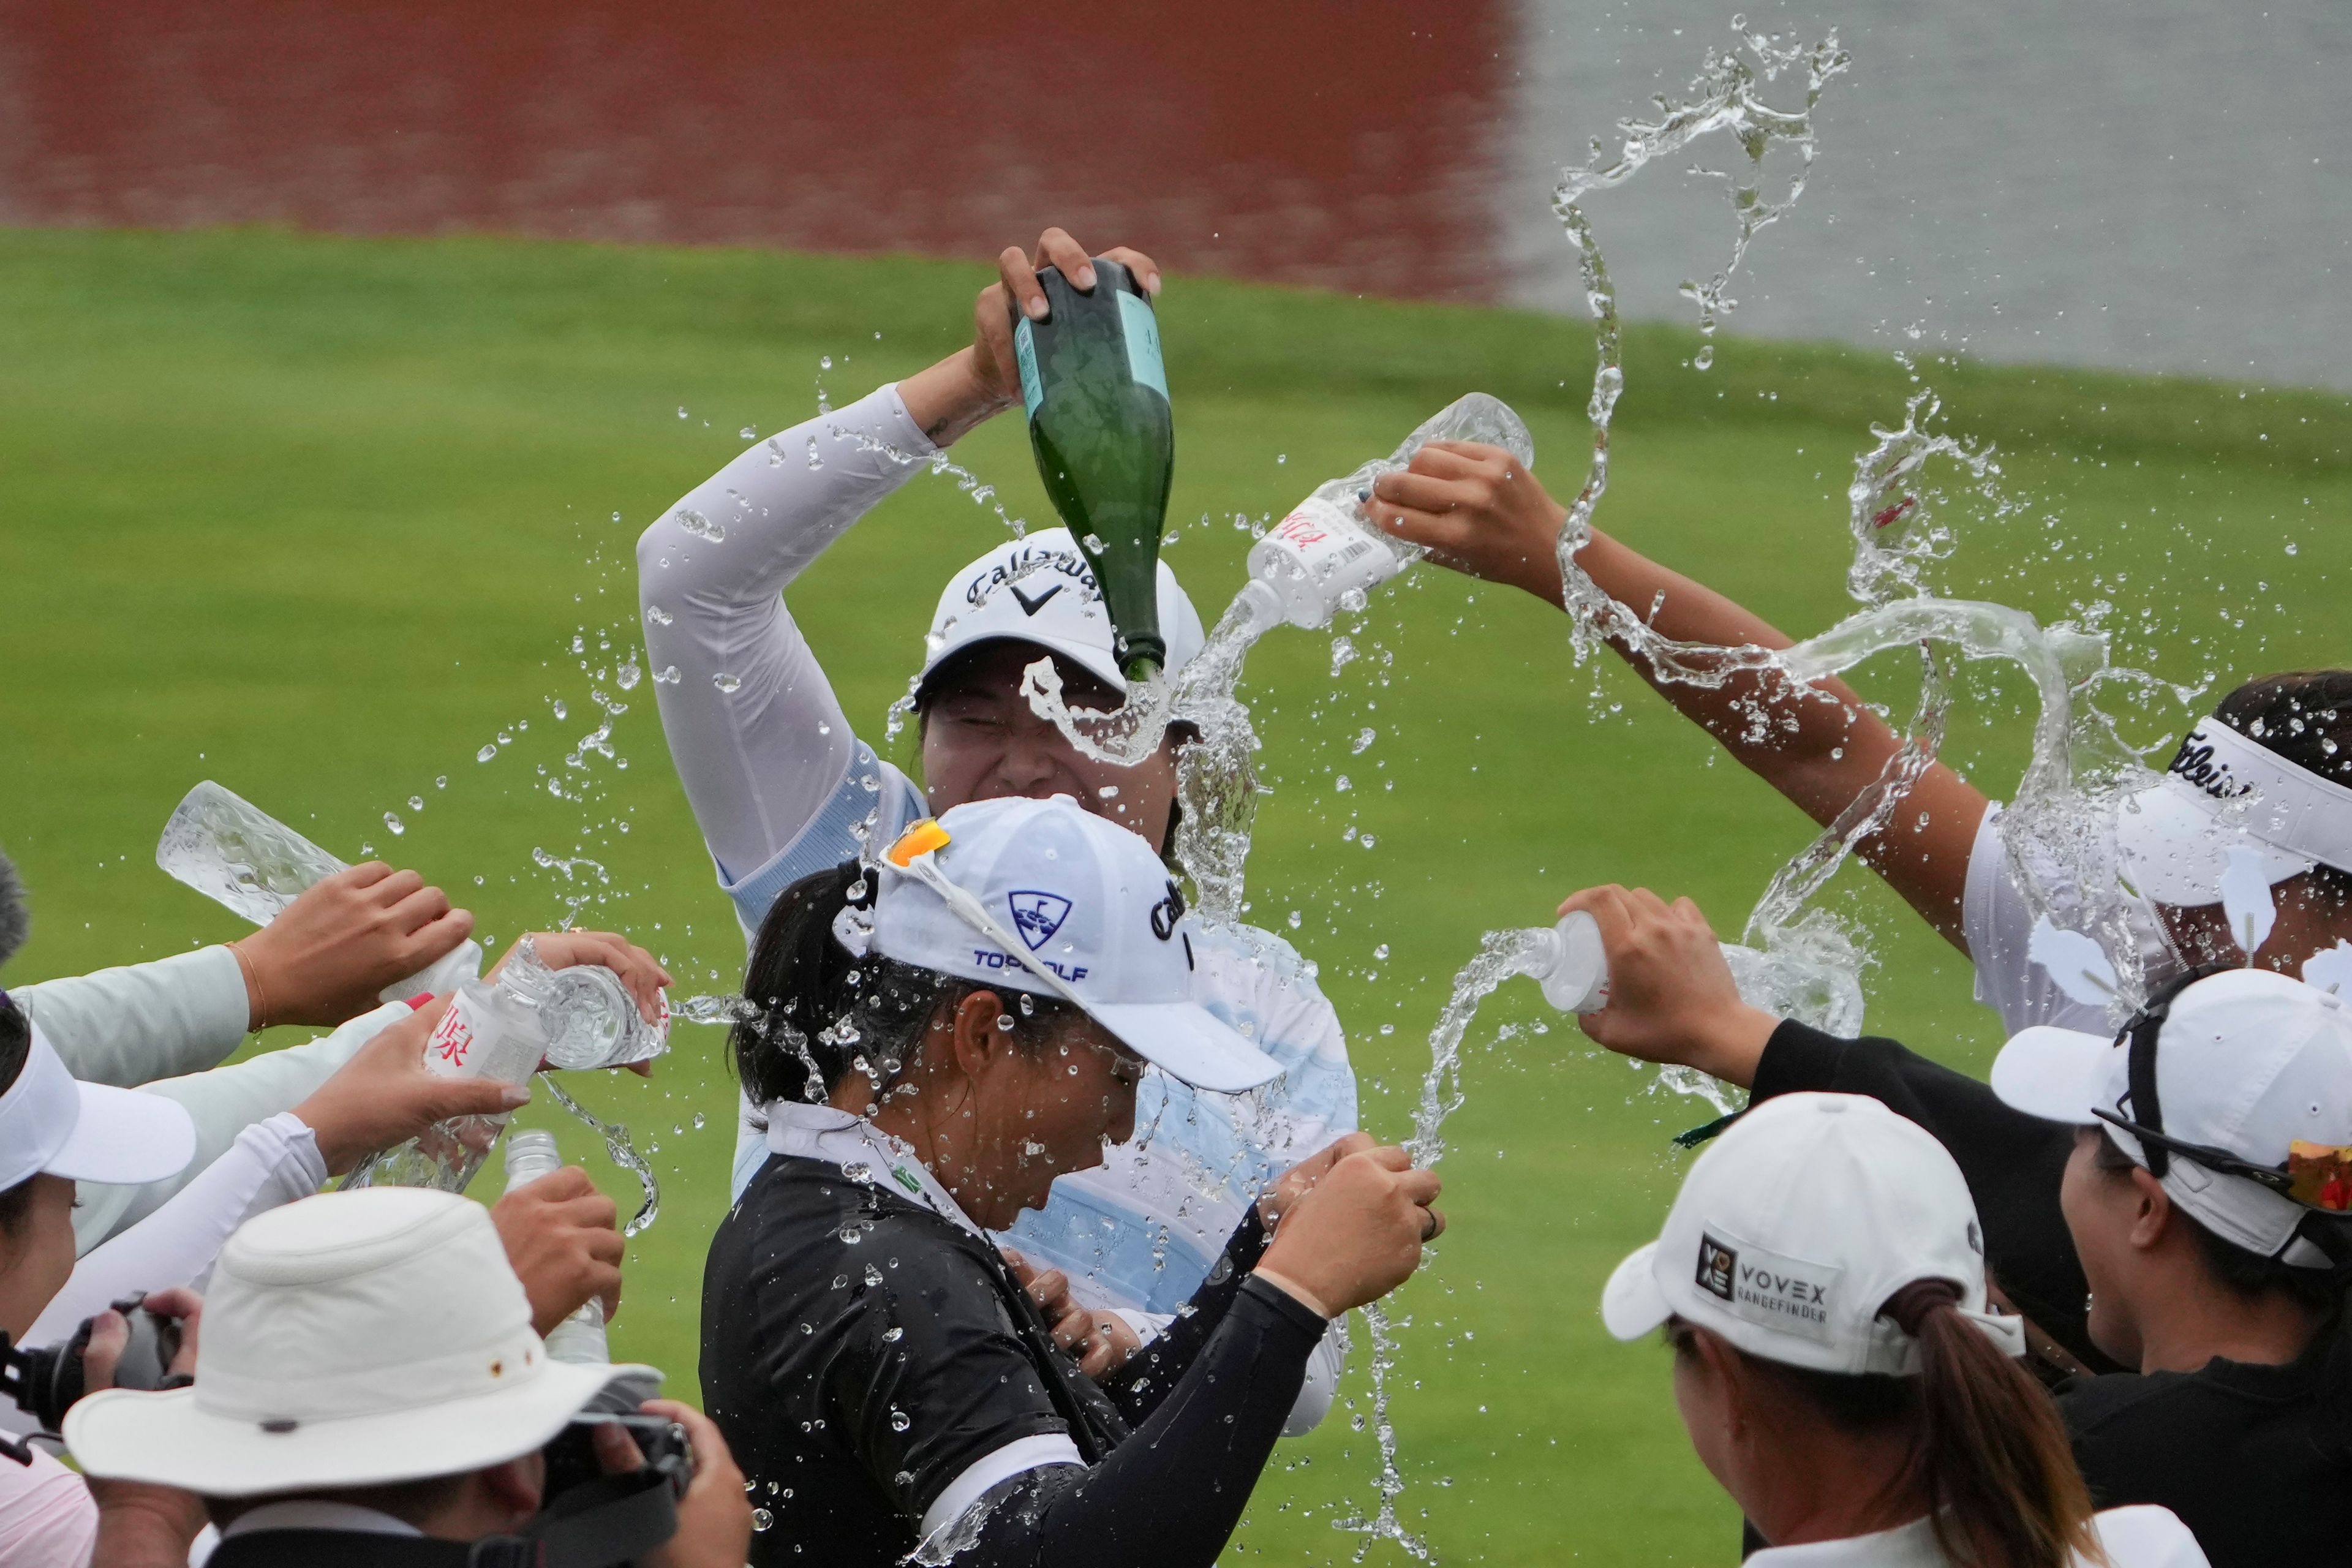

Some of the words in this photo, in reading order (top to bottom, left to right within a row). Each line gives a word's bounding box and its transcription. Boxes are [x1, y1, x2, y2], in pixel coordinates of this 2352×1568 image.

[967, 546, 1104, 603] Callawa
[974, 949, 1088, 982] TOPOLF
[1741, 1263, 1827, 1305] VOVEX
[1738, 1286, 1827, 1324] RANGEFINDER
